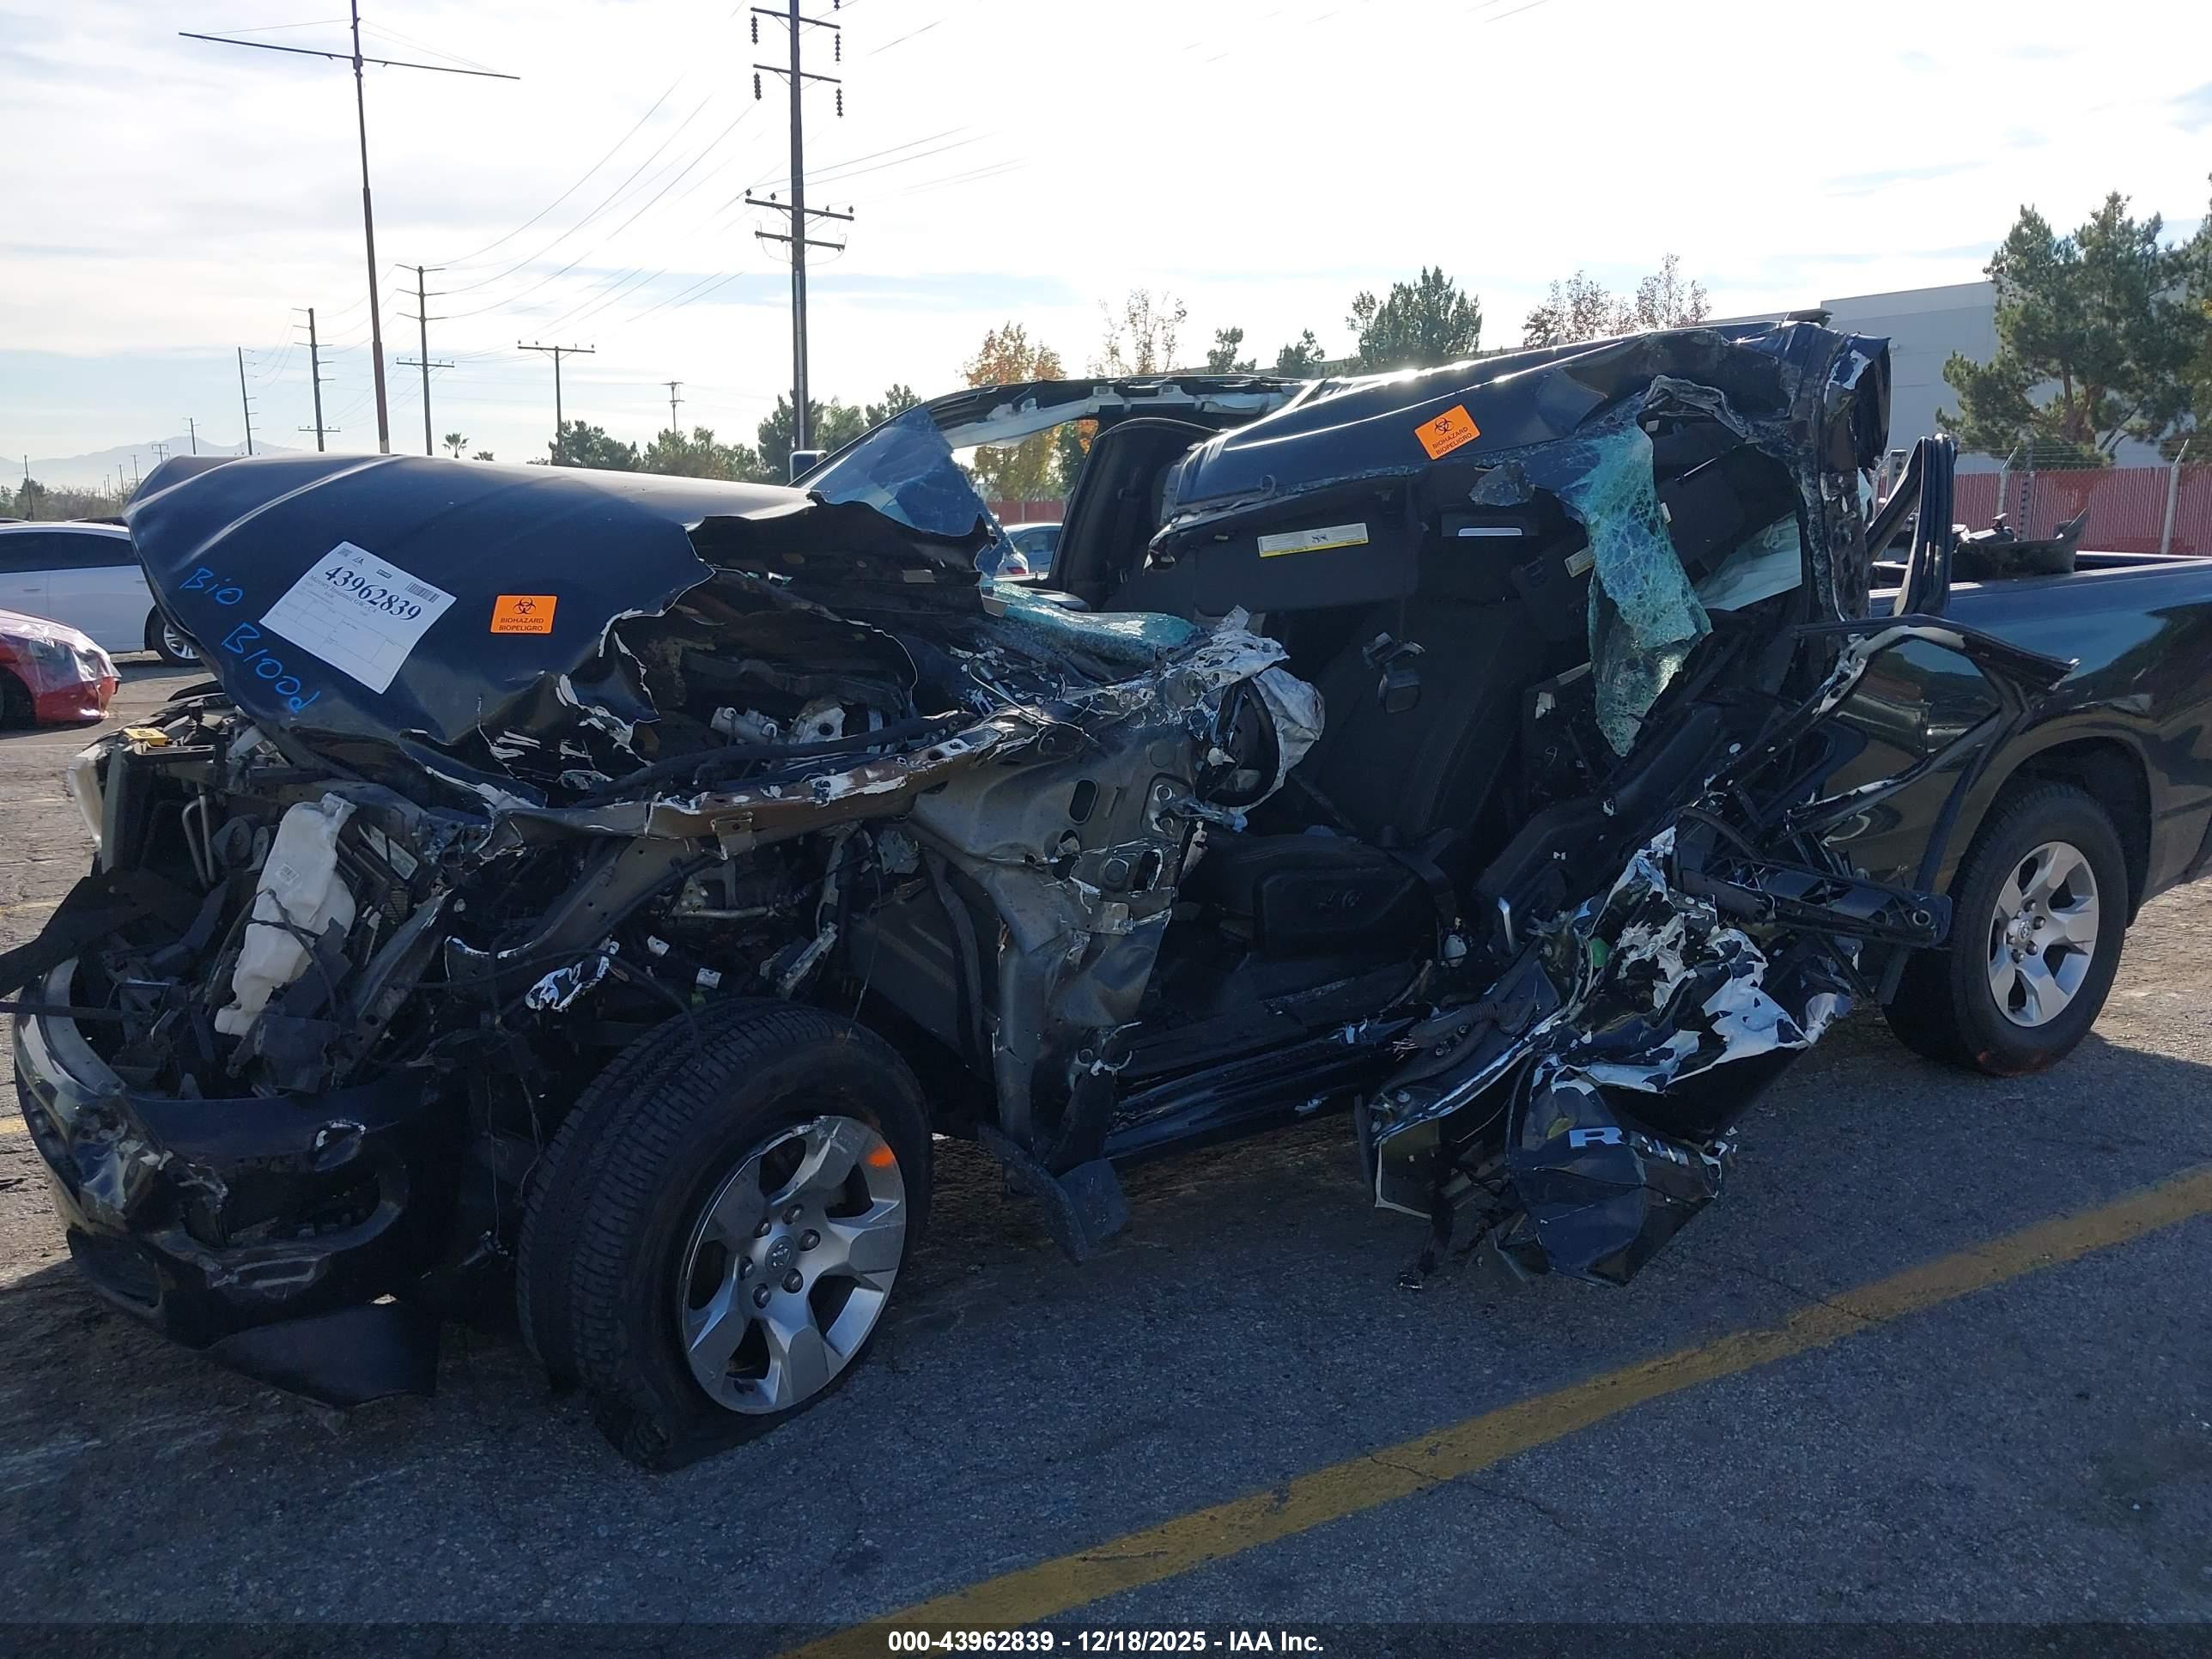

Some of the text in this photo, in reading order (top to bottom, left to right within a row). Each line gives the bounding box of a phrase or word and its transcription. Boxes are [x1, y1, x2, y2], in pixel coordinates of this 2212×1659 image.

[1431, 426, 1468, 449] BIOHAZARD
[1436, 432, 1472, 455] BIOPELIGRO
[325, 566, 422, 621] 43962839
